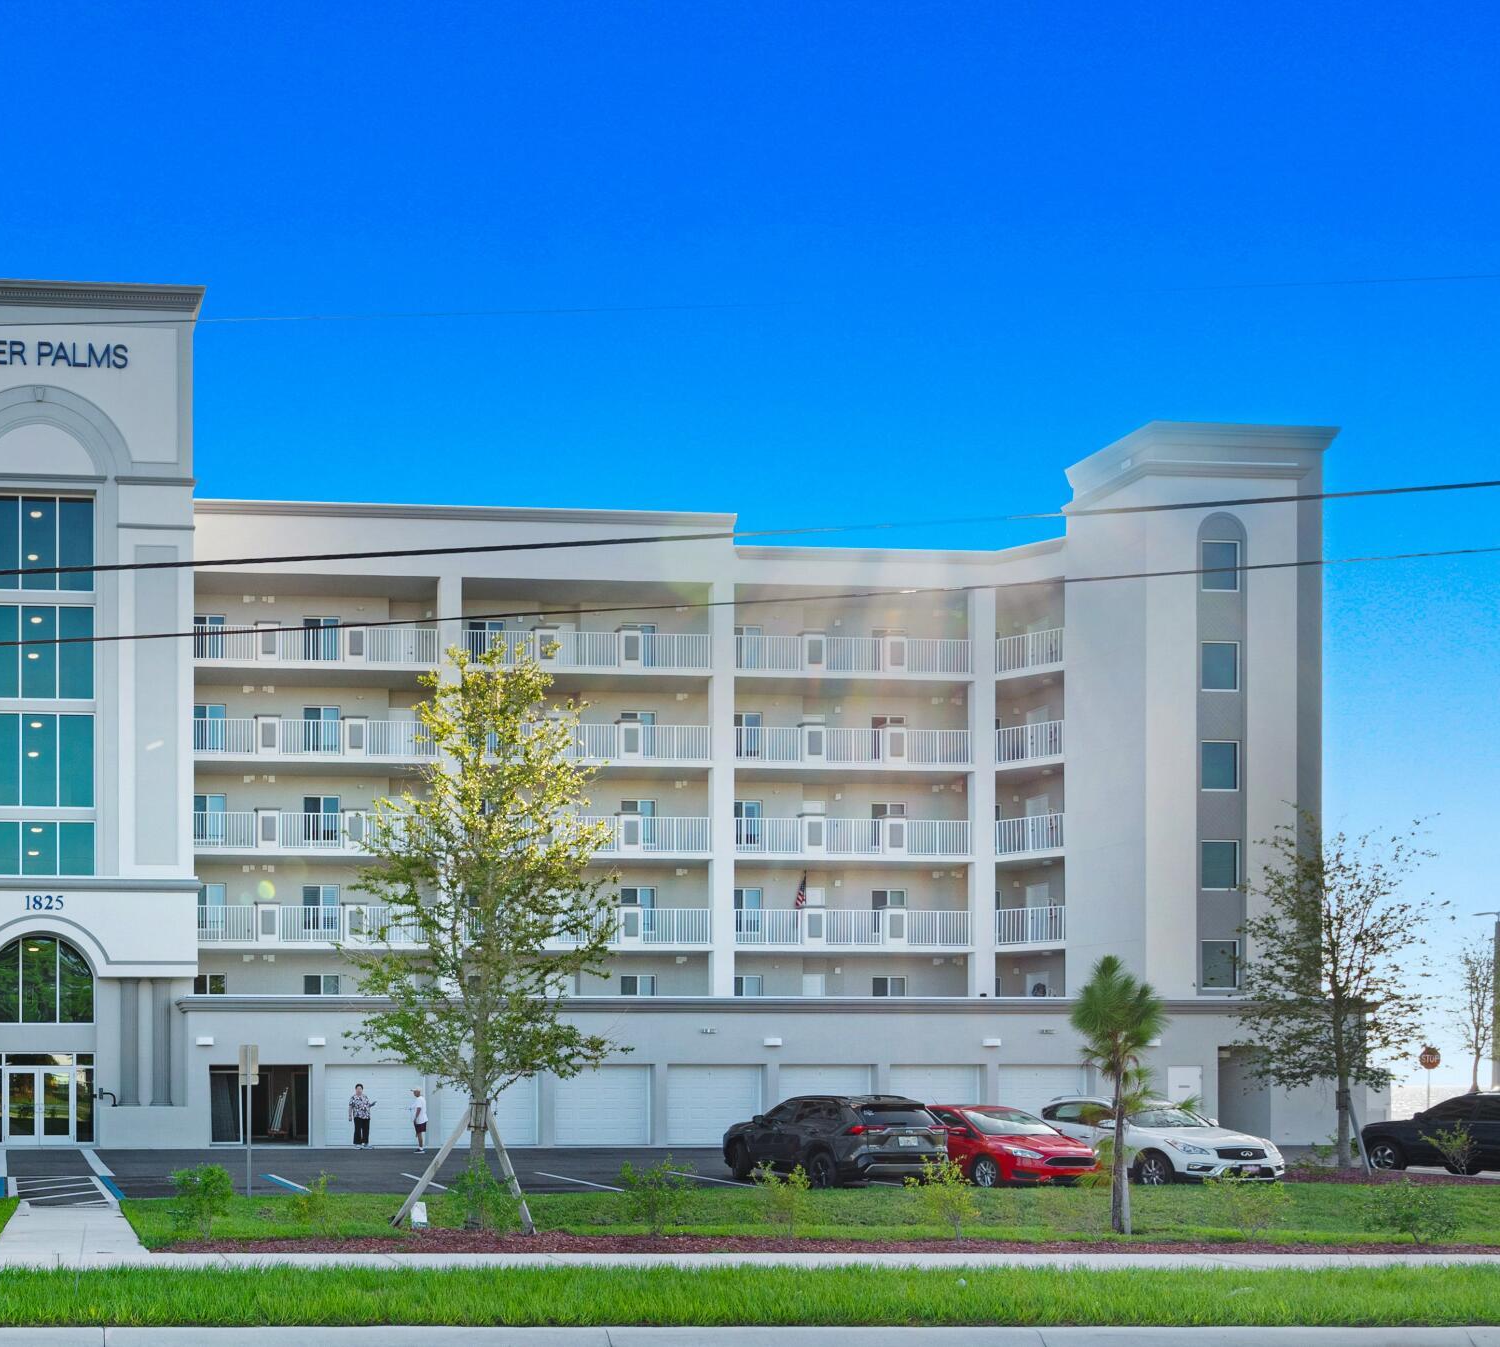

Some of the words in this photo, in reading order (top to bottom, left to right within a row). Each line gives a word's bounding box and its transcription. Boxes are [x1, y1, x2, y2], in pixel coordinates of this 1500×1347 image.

[36, 341, 129, 370] PALMS
[24, 894, 64, 911] 1825
[1421, 1054, 1439, 1064] STOP
